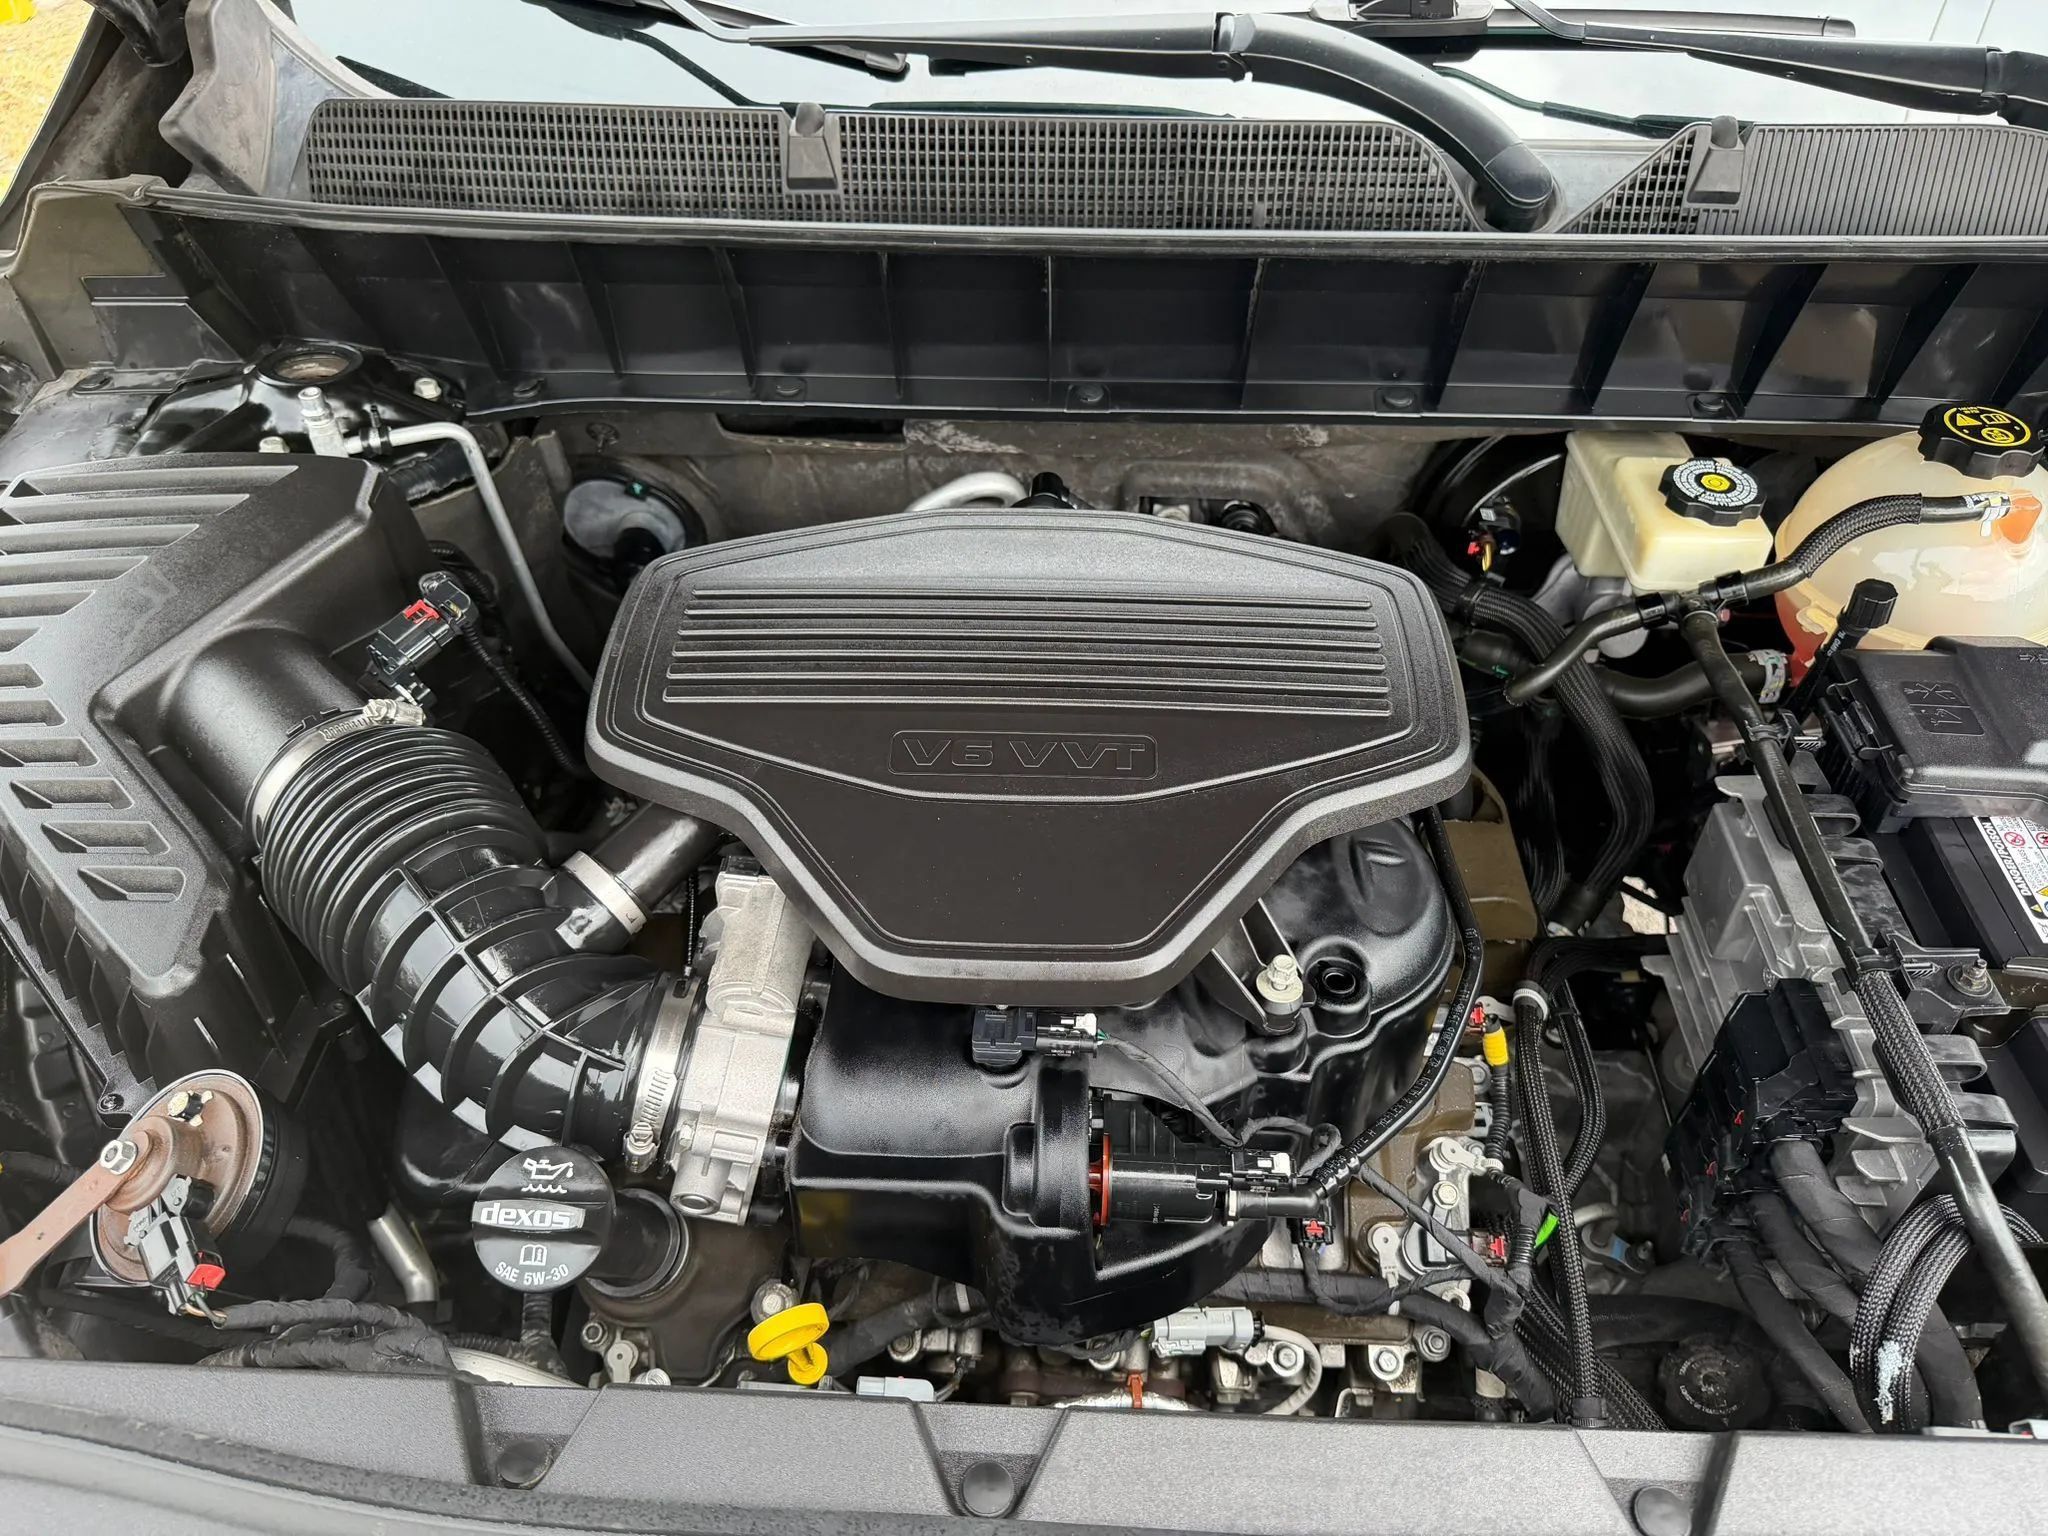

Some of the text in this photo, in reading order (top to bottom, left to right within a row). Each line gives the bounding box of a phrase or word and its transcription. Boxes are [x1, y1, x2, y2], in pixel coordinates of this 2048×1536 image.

[902, 739, 1146, 770] V6 VVT
[1982, 821, 2032, 896] DANGER/POISON
[480, 1202, 575, 1229] dexos
[495, 1261, 569, 1286] SAE 5W-30
